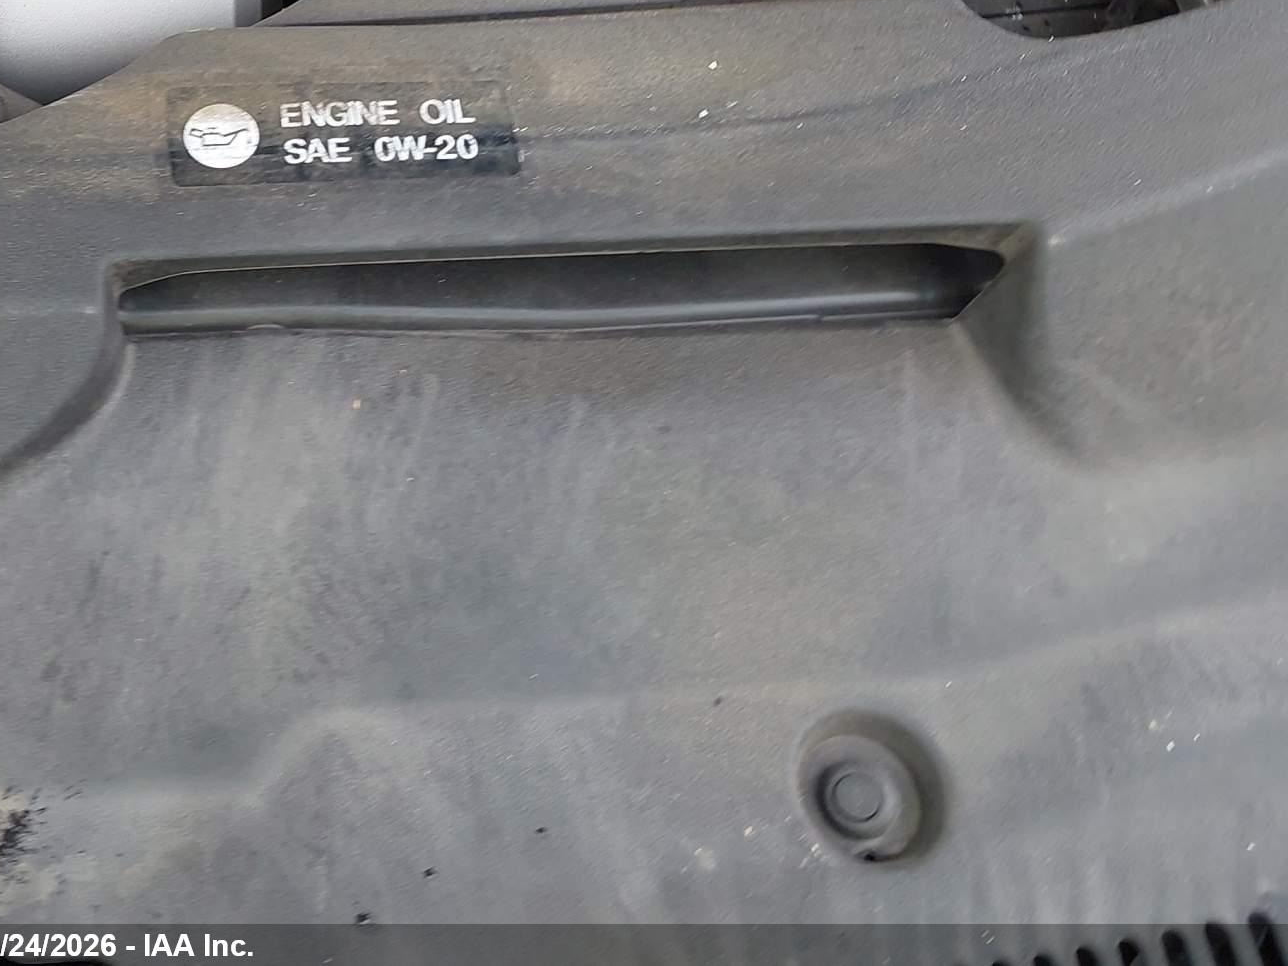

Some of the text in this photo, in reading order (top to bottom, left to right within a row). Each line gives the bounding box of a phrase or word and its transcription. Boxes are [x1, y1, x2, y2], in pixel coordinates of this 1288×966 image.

[279, 98, 476, 128] ENGINE OIL
[282, 134, 479, 164] SAE 0W-20
